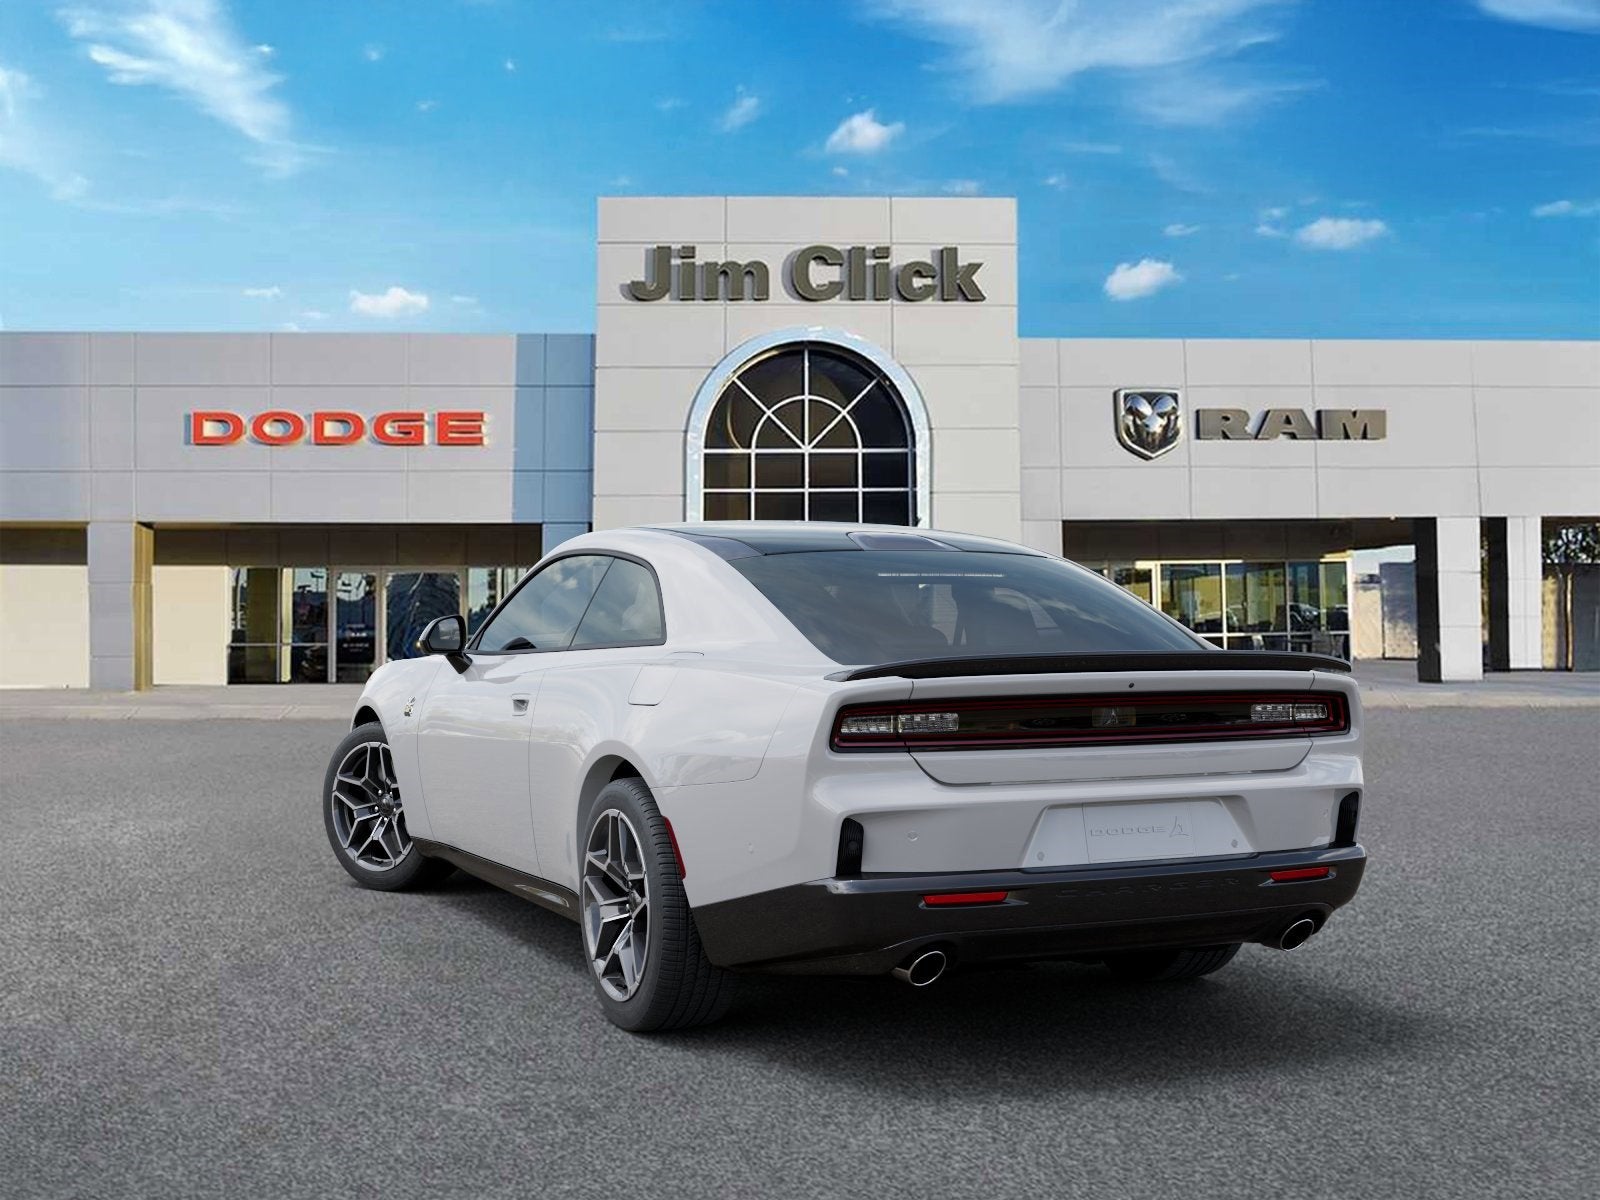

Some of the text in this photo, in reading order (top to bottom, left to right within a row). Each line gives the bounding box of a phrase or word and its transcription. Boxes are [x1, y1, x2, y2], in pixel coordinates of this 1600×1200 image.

[627, 244, 986, 302] Jim Click
[190, 411, 485, 446] DODGE
[1196, 409, 1387, 440] RAM
[1089, 825, 1167, 837] DODGE
